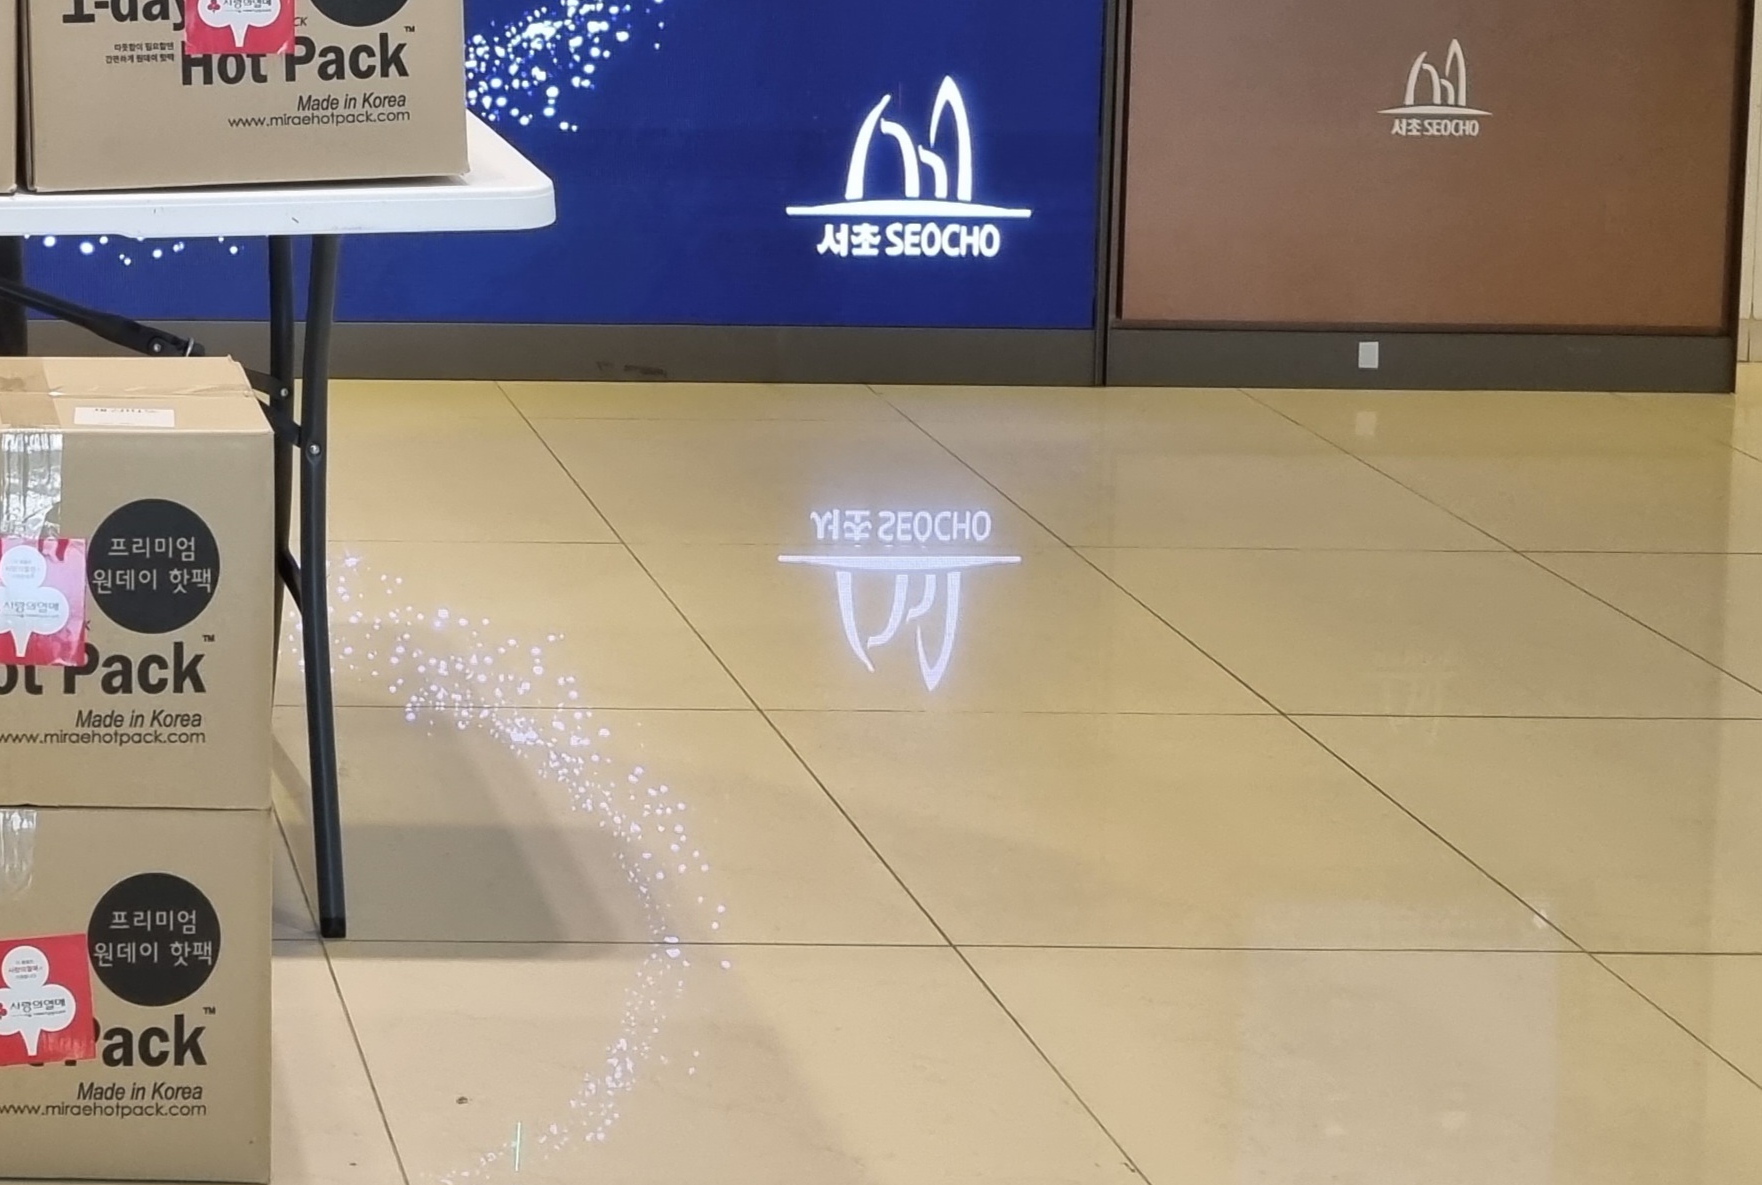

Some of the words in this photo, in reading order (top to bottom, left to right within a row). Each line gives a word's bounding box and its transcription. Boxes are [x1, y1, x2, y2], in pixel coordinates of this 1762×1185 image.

[284, 32, 409, 83] Pack
[297, 95, 340, 112] Made
[343, 95, 358, 111] in
[362, 92, 406, 109] Korea
[228, 110, 410, 128] www.miraehotpack.com
[1391, 118, 1421, 136] 서초
[1423, 119, 1480, 136] SEOCHO
[817, 222, 881, 257] 서초
[885, 222, 1001, 257] SEOCHO
[108, 537, 196, 560] 프리미엄
[92, 568, 158, 594] 원데이
[169, 568, 213, 594] 핫팩
[63, 641, 206, 695] Pack
[75, 709, 126, 728] Made
[129, 709, 146, 728] in
[150, 709, 203, 728] Korea
[110, 910, 198, 934] 프리미엄
[94, 941, 159, 968] 원데이
[171, 941, 213, 967] 핫팩
[63, 1013, 207, 1068] ack
[77, 1082, 128, 1102] Made
[131, 1082, 147, 1102] in
[151, 1082, 203, 1101] Korea
